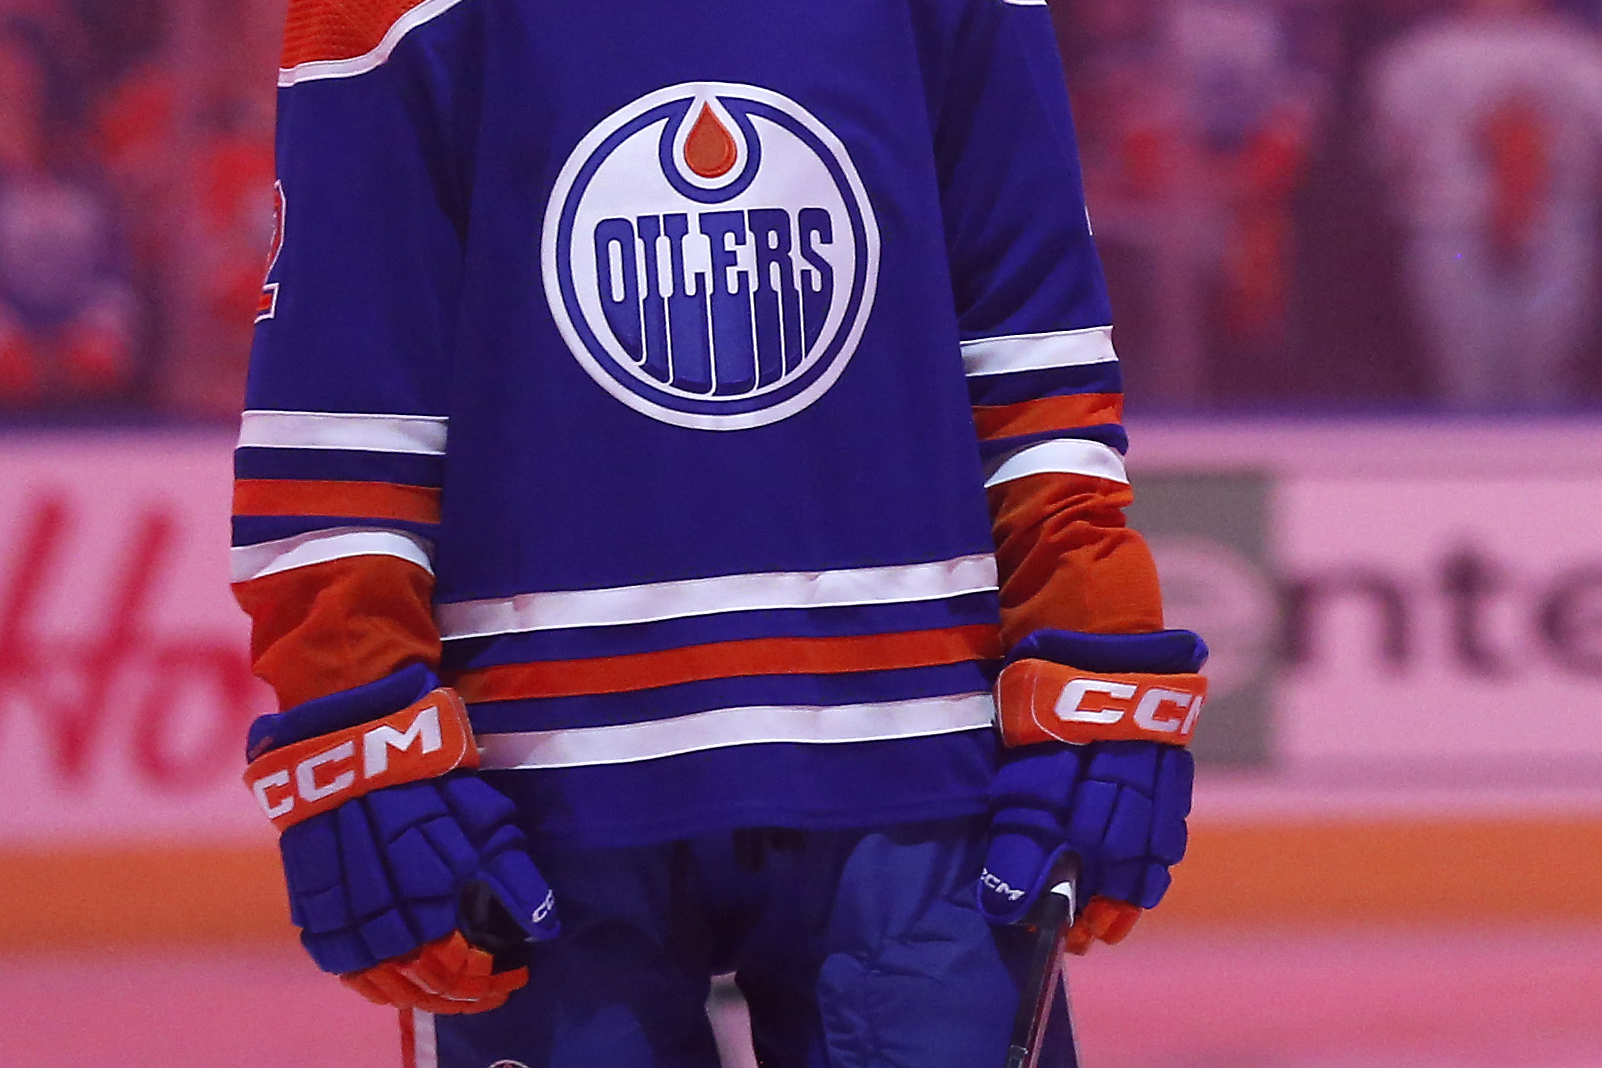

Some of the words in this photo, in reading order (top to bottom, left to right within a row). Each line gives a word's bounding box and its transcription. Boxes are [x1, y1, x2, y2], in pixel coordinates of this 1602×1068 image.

[593, 207, 834, 397] OILERS
[253, 706, 443, 819] CCM
[1054, 679, 1203, 734] CC
